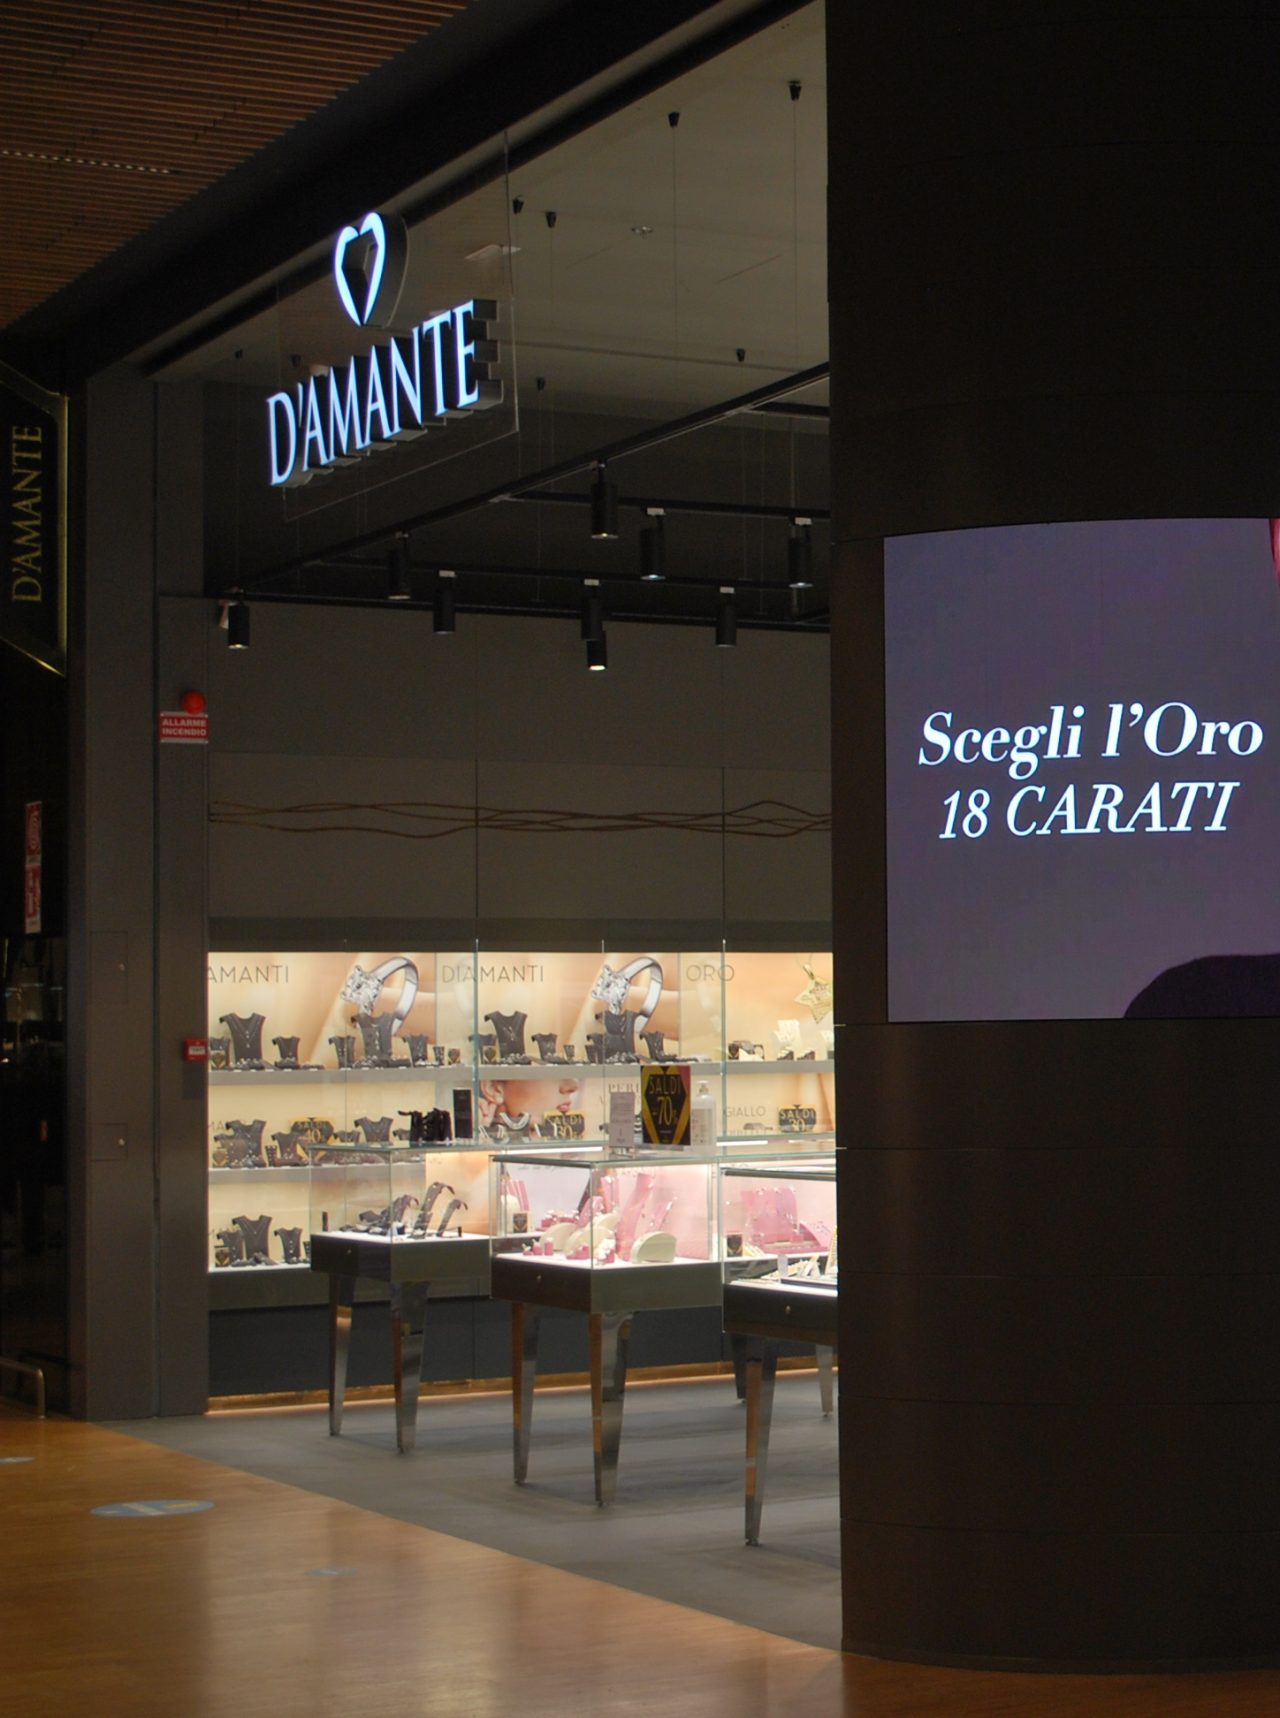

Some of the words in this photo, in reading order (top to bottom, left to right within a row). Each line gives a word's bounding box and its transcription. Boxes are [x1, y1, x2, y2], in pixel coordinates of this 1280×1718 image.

[266, 299, 479, 486] D'AMANTE
[11, 425, 44, 602] D'AMANTE
[162, 718, 207, 728] ALLARME
[162, 728, 207, 737] INCENDIO
[918, 705, 1085, 780] Scegli
[1101, 701, 1264, 757] l'Oro
[939, 788, 991, 840] 18
[1006, 781, 1241, 837] CARATI
[442, 964, 544, 984] DIAMANTI
[686, 964, 735, 982] ORO
[649, 1076, 681, 1095] SALDI
[780, 1109, 815, 1120] SALDI
